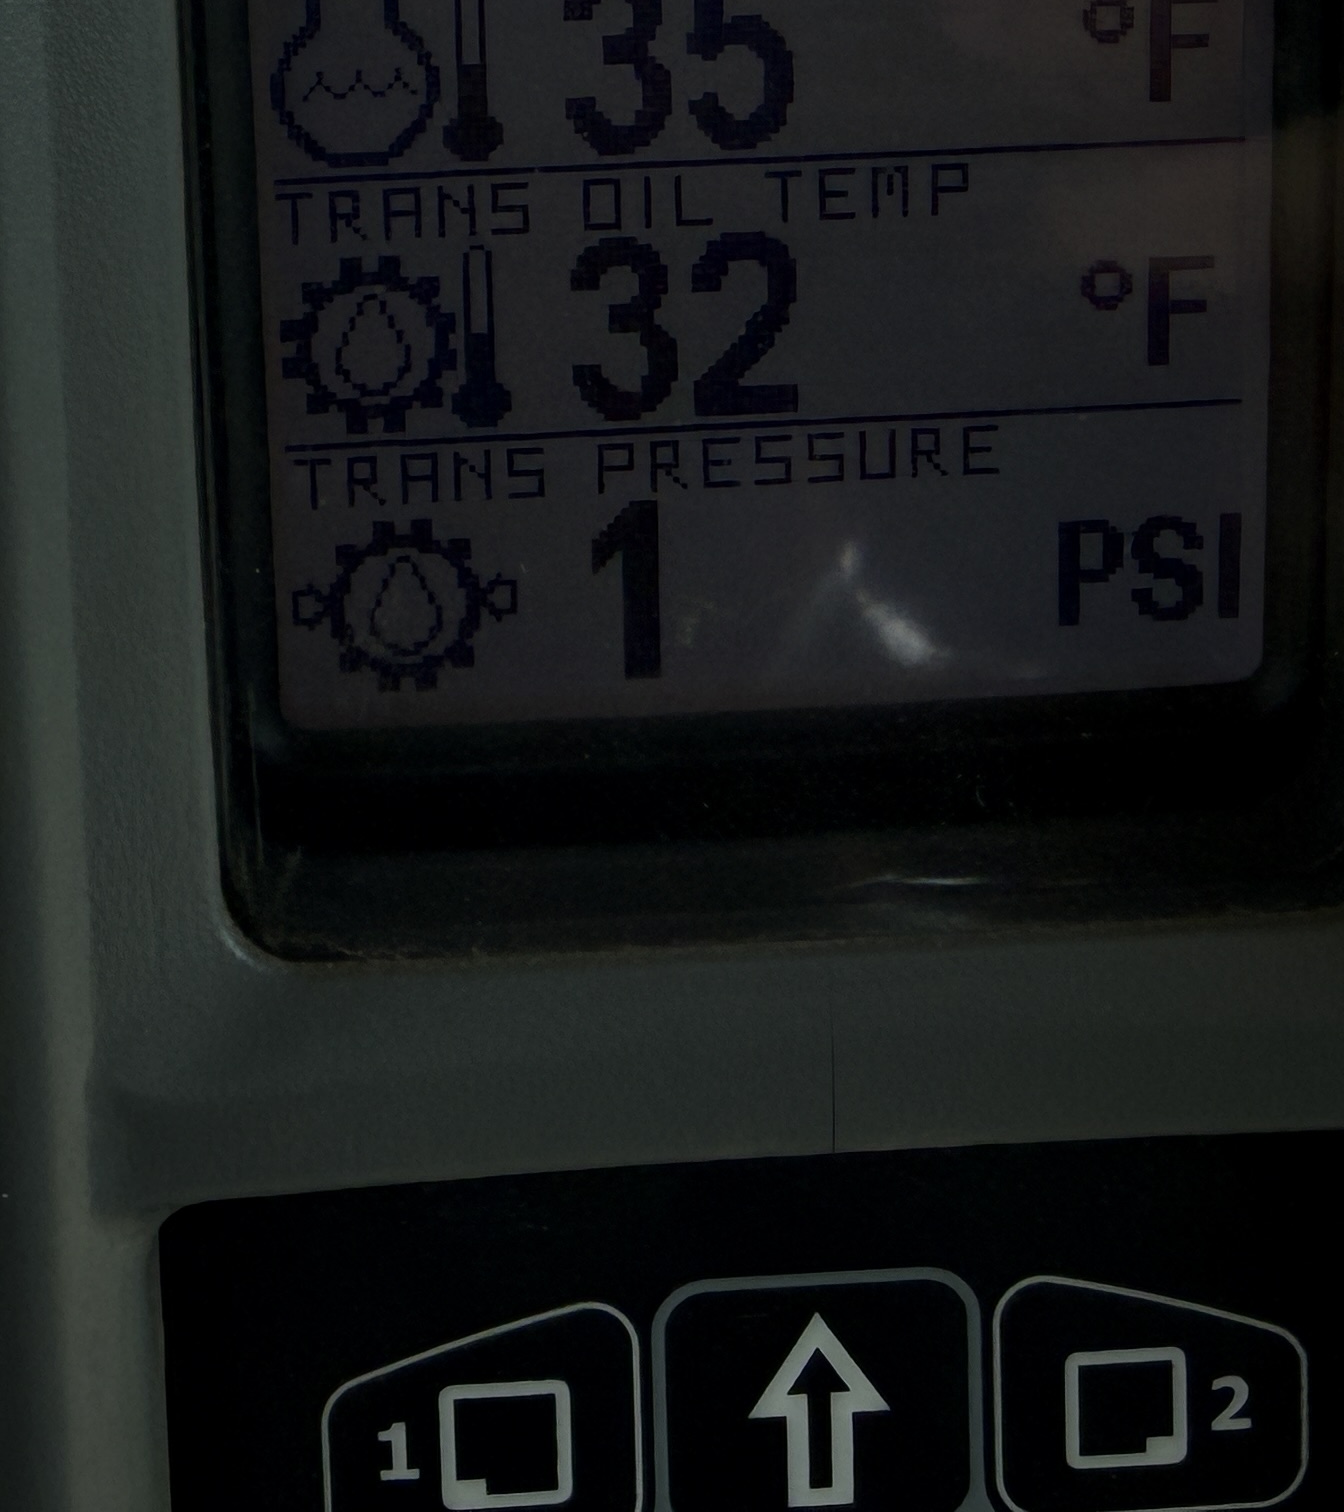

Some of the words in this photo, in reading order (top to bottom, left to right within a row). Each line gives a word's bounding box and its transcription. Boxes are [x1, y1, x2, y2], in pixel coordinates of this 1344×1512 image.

[275, 182, 530, 244] TRANS
[583, 173, 713, 231] OIL
[766, 163, 970, 223] TEMP
[570, 231, 798, 421] 32
[1080, 256, 1216, 366] °F
[292, 446, 546, 510] TRANS
[597, 426, 1001, 492] PRESSURE
[590, 500, 661, 679] 1
[1057, 513, 1242, 627] PSI
[1209, 1376, 1253, 1431] 2
[377, 1422, 421, 1481] 1
